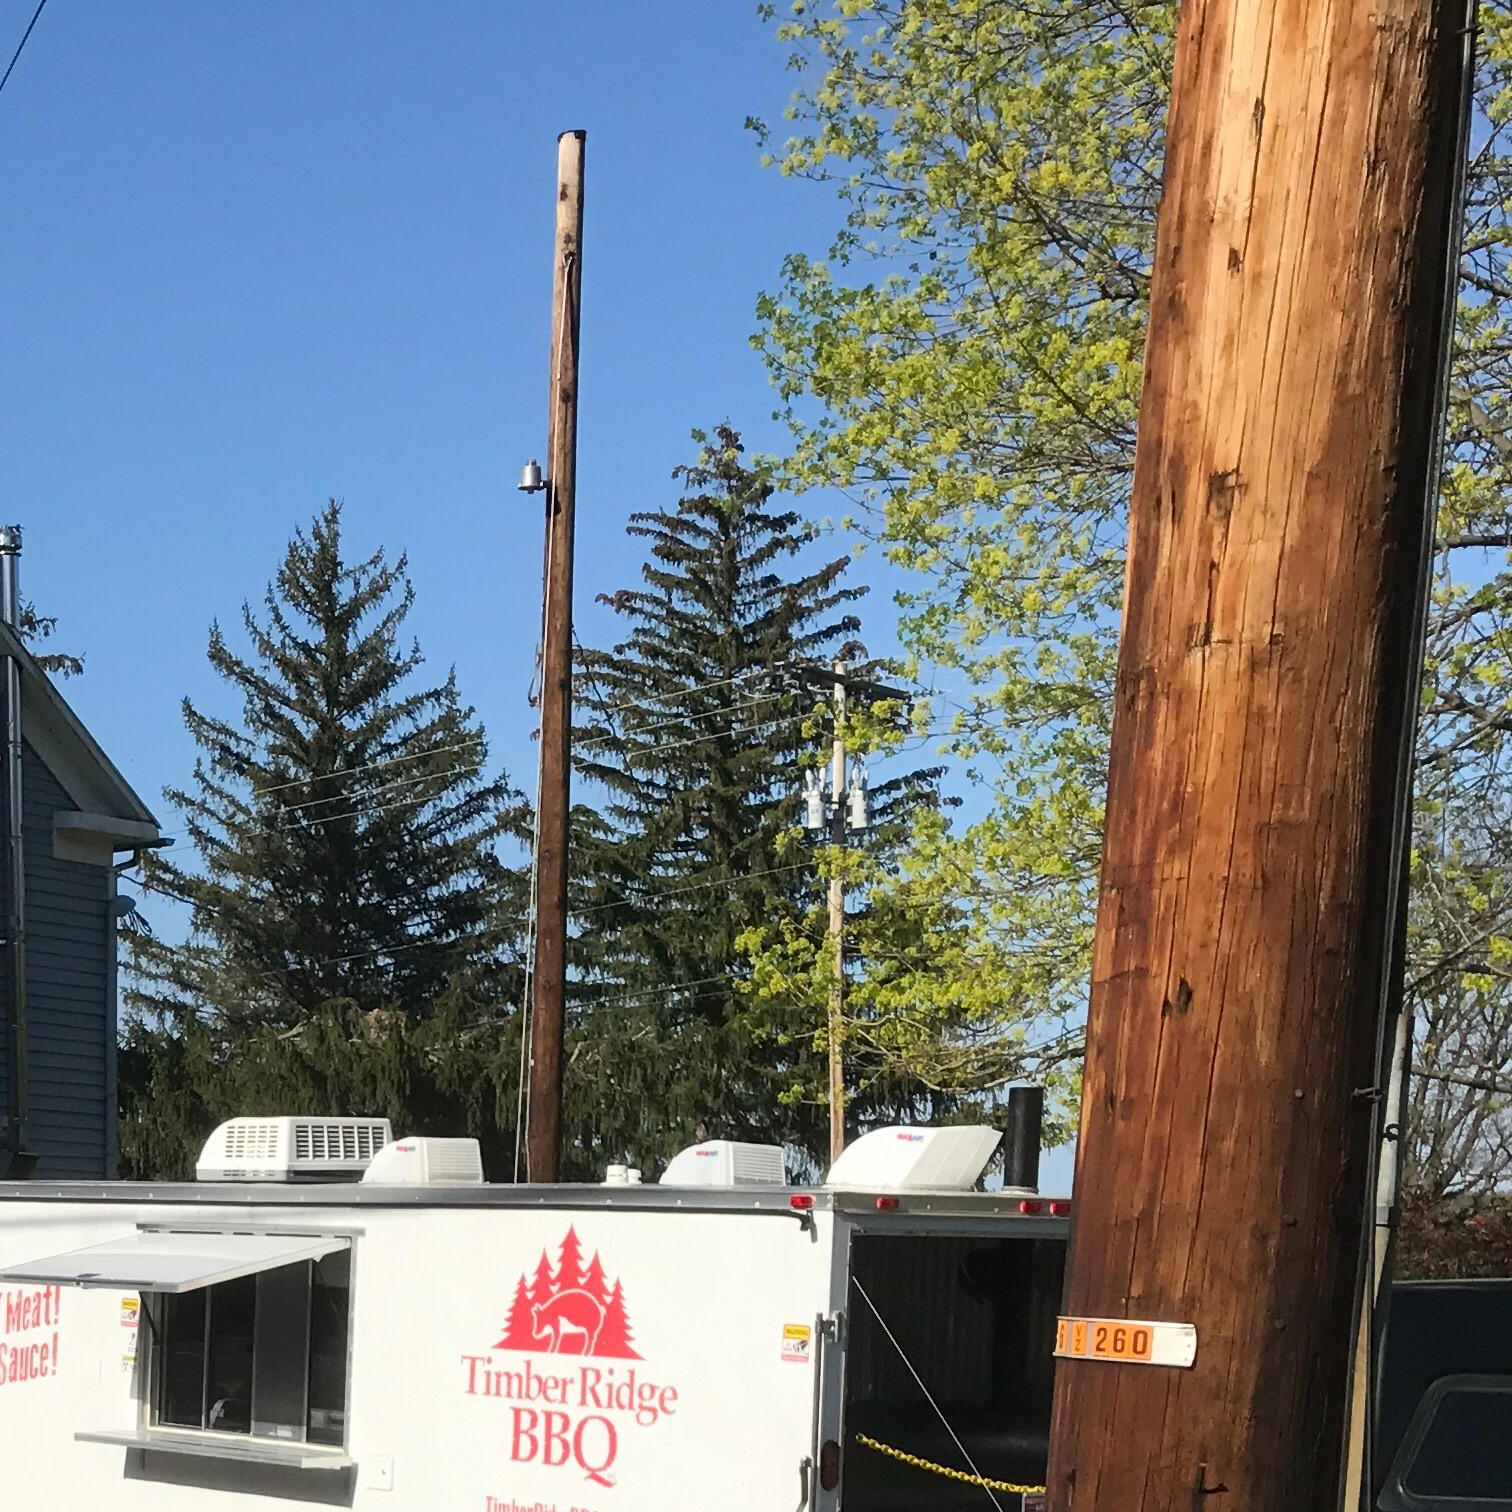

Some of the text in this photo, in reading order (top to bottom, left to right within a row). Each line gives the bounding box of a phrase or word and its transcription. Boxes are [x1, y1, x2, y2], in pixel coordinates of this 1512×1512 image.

[5, 1282, 61, 1334] Meat!
[1095, 1327, 1148, 1355] 260
[509, 1406, 618, 1488] BBQ
